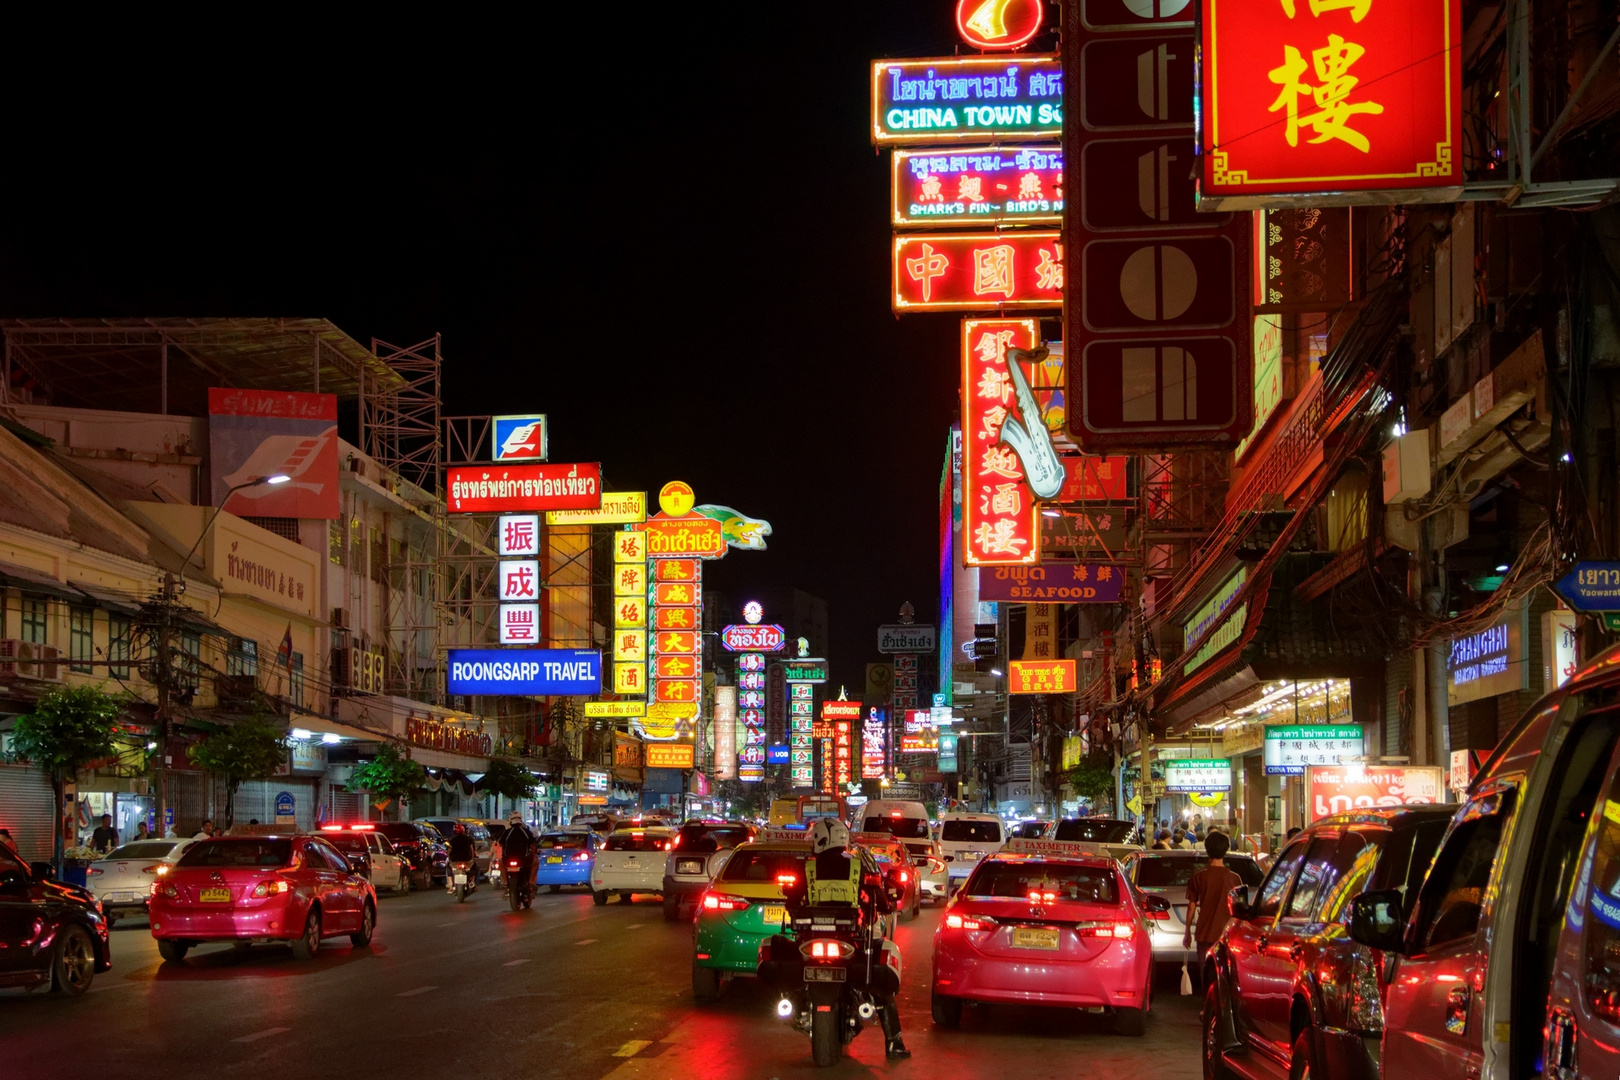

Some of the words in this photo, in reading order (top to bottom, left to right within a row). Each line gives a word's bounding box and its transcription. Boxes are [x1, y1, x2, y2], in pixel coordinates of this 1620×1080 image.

[889, 67, 1018, 101] ไชน่าทาวน์
[1267, 0, 1385, 154] 樓
[887, 108, 958, 129] CHINA
[964, 105, 1032, 126] TOWN
[910, 202, 965, 215] SHARK'S
[1006, 200, 1049, 212] BIRD'S
[452, 464, 596, 509] รุ่งทรัพย์การท่องเที่ยว
[1054, 535, 1100, 548] NEST
[504, 521, 536, 641] 振成豐
[1072, 565, 1112, 583] 海鮮
[1010, 587, 1097, 599] SEAFOOD
[662, 560, 692, 700] 蘇成興大金行
[1453, 624, 1508, 666] SHANGHAI
[453, 662, 539, 682] ROONGSARP
[544, 661, 596, 681] TRAVEL
[1300, 728, 1336, 738] ไชน่าทาวน์
[1338, 728, 1361, 738] สกาล่า
[1267, 766, 1286, 774] CHINA
[1286, 765, 1304, 774] TOWN
